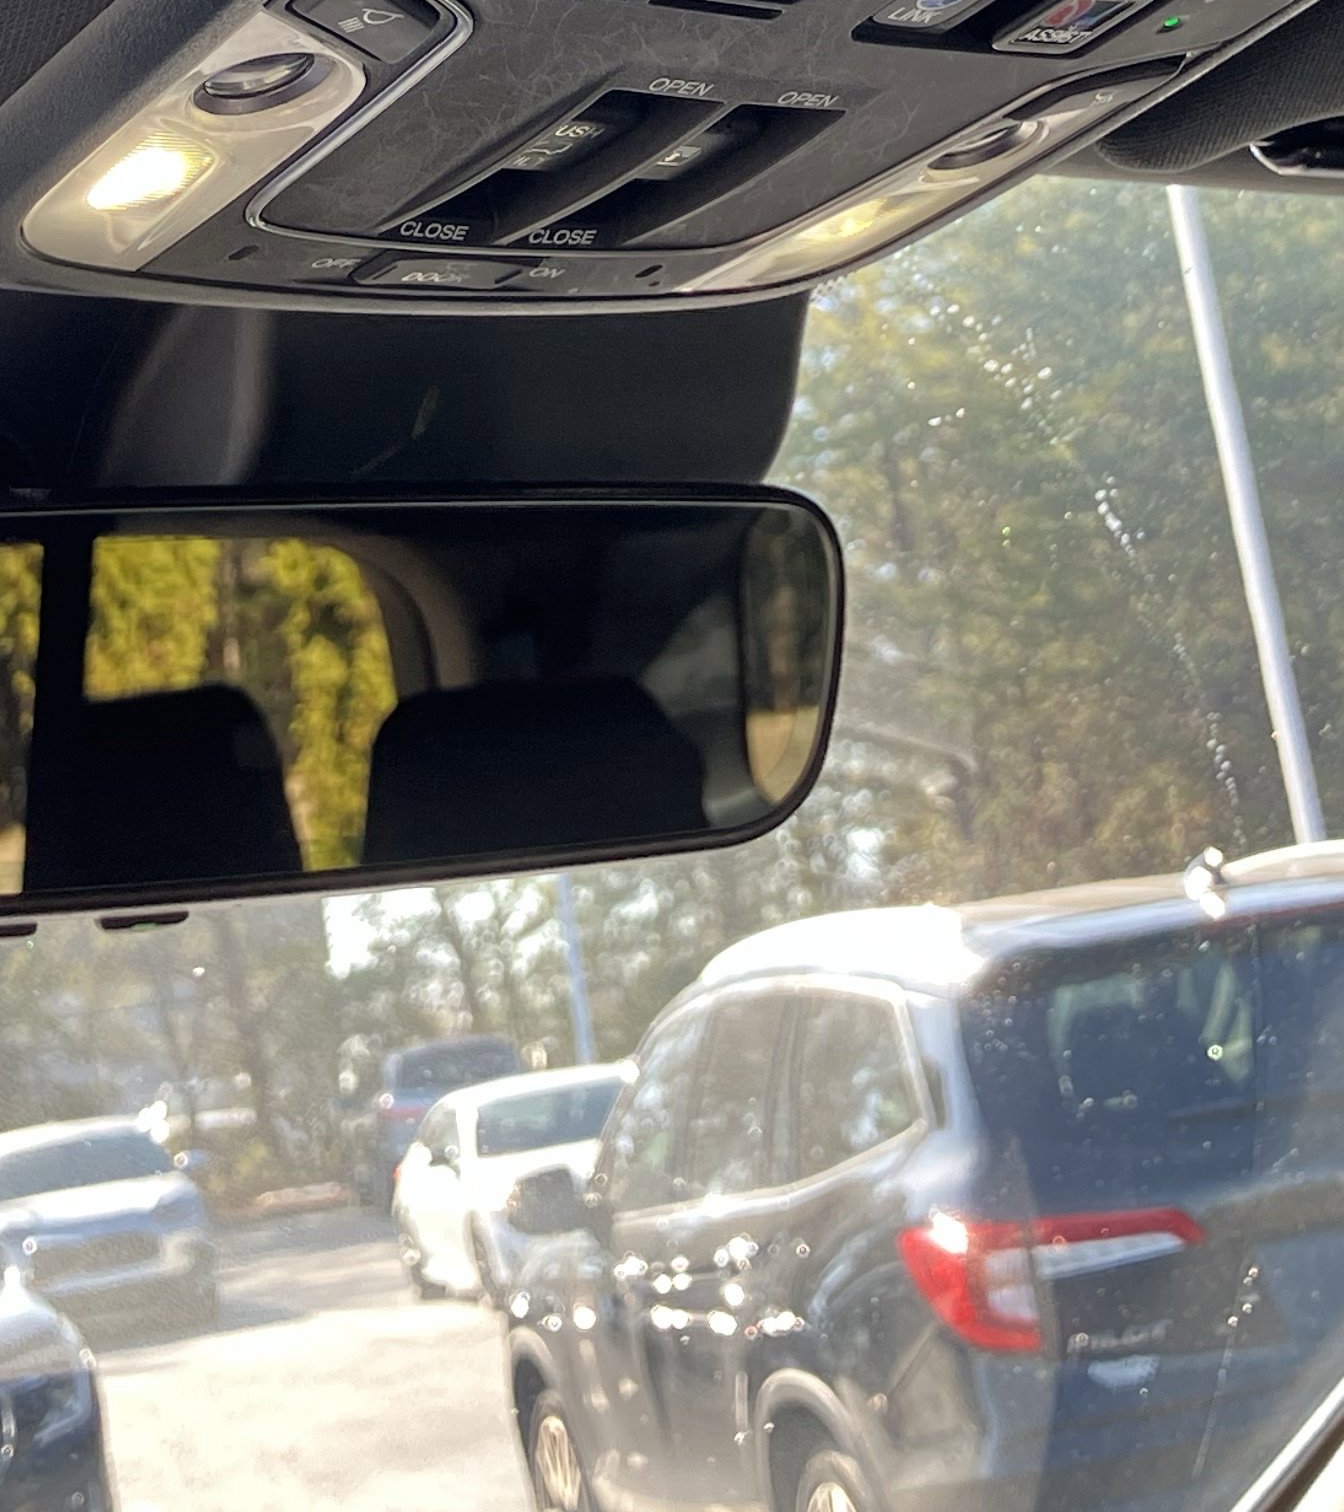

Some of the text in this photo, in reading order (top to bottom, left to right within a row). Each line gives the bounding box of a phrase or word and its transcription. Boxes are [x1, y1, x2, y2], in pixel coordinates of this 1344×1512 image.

[887, 6, 944, 25] LINK
[648, 77, 715, 97] OPEN
[777, 91, 840, 109] OPEN
[554, 125, 606, 139] USH
[399, 220, 470, 242] CLOSE
[528, 228, 598, 246] CLOSE
[311, 257, 361, 269] OFF
[528, 266, 567, 279] ON
